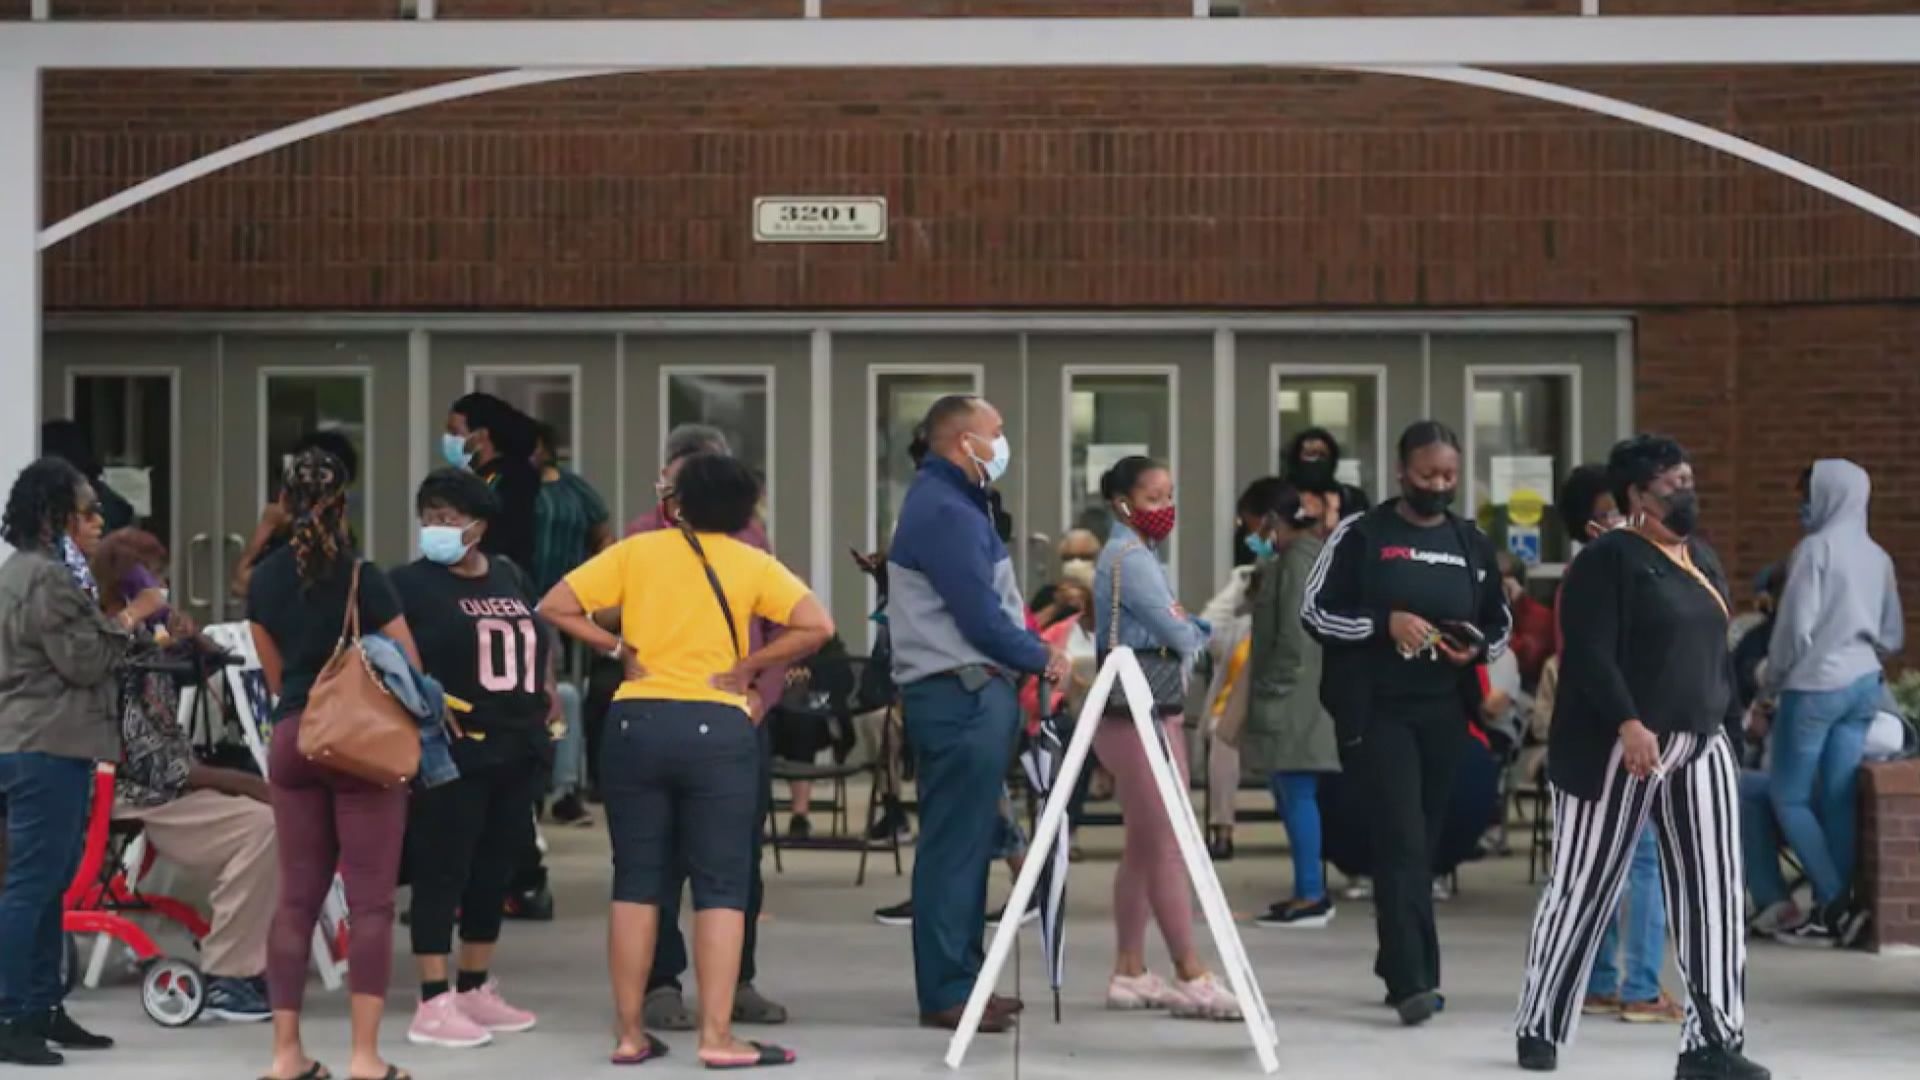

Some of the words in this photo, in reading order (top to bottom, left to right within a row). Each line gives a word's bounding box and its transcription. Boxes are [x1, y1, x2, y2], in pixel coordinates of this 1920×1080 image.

[779, 206, 857, 221] 3201
[459, 598, 531, 617] QUEEN
[477, 619, 537, 693] 01
